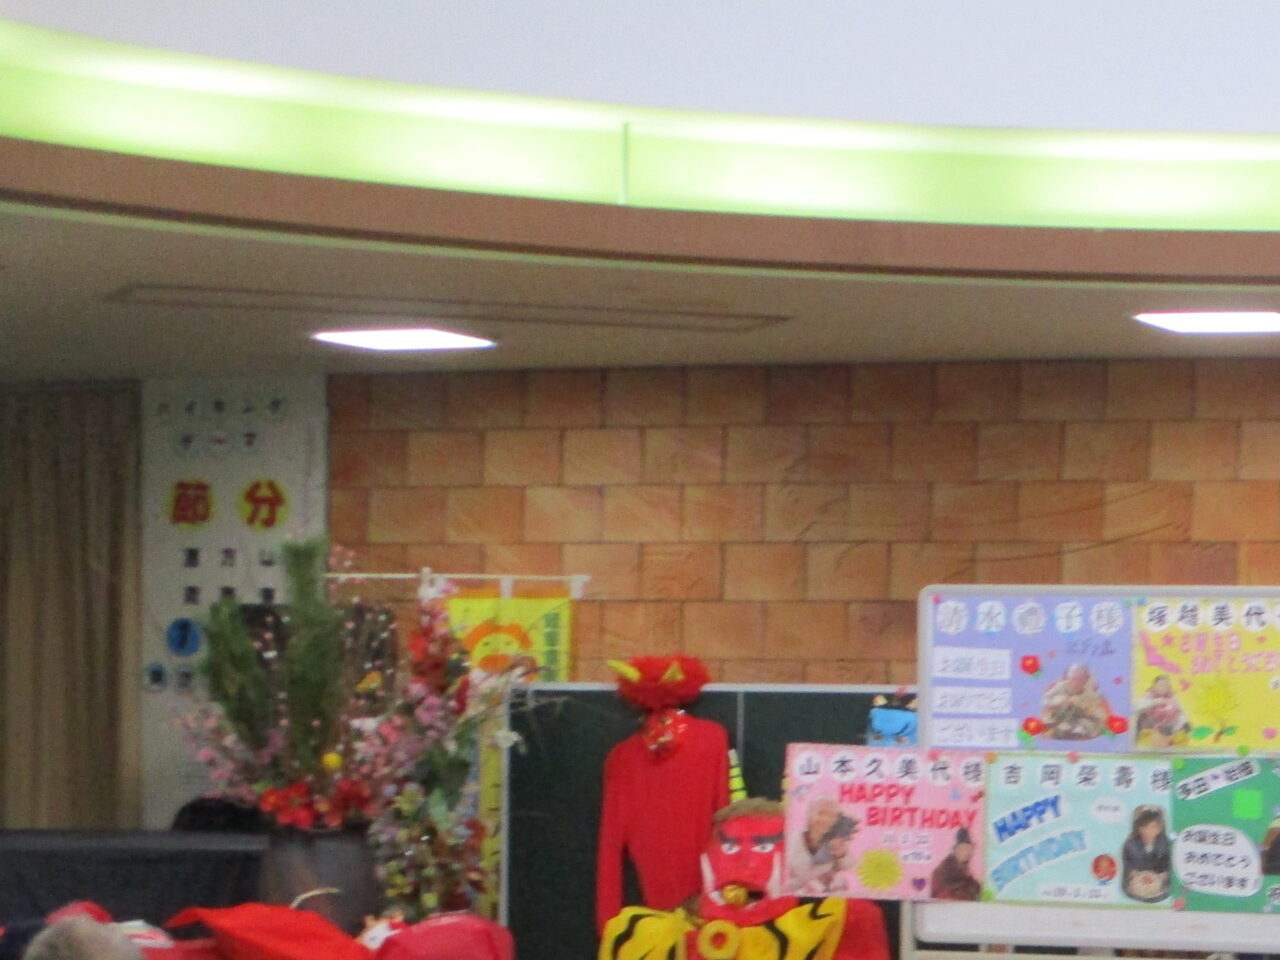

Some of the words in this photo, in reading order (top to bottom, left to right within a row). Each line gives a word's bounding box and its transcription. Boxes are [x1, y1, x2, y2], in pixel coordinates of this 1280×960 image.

[171, 480, 286, 527] 節分
[839, 783, 915, 804] HAPPY
[866, 806, 978, 829] BIRTHDAY
[993, 794, 1062, 843] HAPPY
